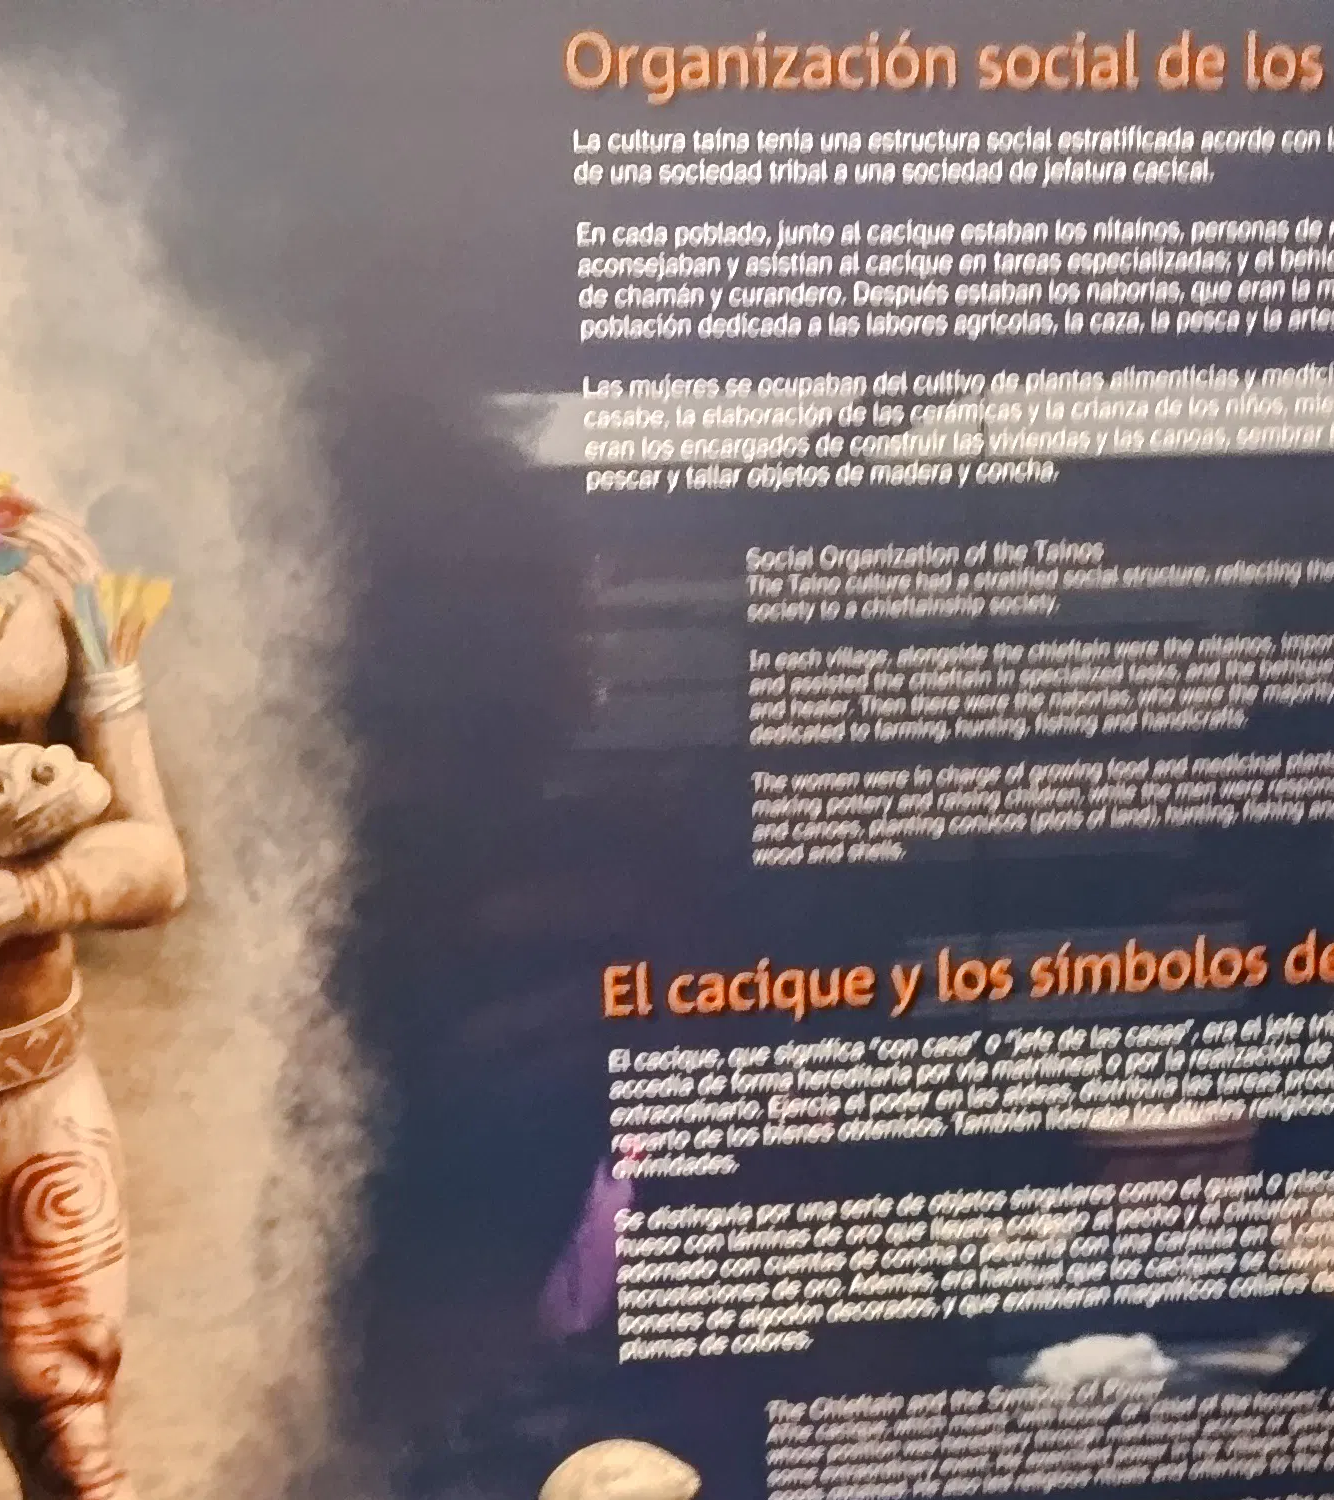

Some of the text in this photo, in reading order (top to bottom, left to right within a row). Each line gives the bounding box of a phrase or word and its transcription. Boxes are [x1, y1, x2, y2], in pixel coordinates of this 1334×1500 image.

[565, 29, 957, 104] Organización
[978, 29, 1140, 90] social
[1159, 29, 1226, 90] de
[1247, 29, 1324, 91] los
[572, 129, 602, 153] La
[607, 128, 686, 153] cultura
[820, 132, 862, 152] una
[868, 127, 981, 152] estructura
[986, 127, 1053, 152] social
[1057, 126, 1195, 151] estratificada
[1201, 126, 1275, 151] acorde
[1281, 131, 1321, 151] con
[573, 159, 604, 185] de
[609, 164, 653, 185] una
[658, 158, 763, 185] sociedad
[769, 158, 828, 184] tribal
[832, 163, 848, 184] a
[854, 163, 896, 184] una
[901, 158, 1004, 184] sociedad
[1008, 158, 1039, 184] de
[1042, 157, 1127, 187] jefatura
[576, 221, 607, 247] En
[611, 221, 668, 247] cada
[776, 220, 835, 249] junto
[839, 219, 861, 245] al
[866, 219, 956, 248] cacique
[960, 218, 1049, 243] estaban
[1054, 217, 1088, 243] los
[1189, 221, 1290, 245] personas
[1294, 216, 1324, 241] de
[577, 253, 722, 282] aconsejaban
[725, 257, 739, 280] y
[839, 251, 861, 275] al
[865, 250, 953, 279] cacique
[959, 254, 987, 274] en
[992, 248, 1063, 274] tareas
[1236, 251, 1248, 275] y
[1254, 246, 1275, 271] el
[578, 285, 609, 308] de
[710, 288, 724, 311] y
[954, 279, 1043, 303] estaban
[1048, 278, 1081, 302] los
[1190, 281, 1233, 305] que
[1237, 281, 1286, 301] eran
[1291, 276, 1311, 300] la
[697, 312, 802, 338] dedicada
[808, 317, 823, 337] a
[827, 311, 861, 337] las
[865, 310, 949, 336] labores
[1063, 308, 1084, 334] la
[1150, 307, 1171, 332] la
[1176, 311, 1241, 336] pesca
[1245, 310, 1258, 335] y
[1262, 305, 1283, 331] la
[582, 376, 624, 399] Las
[628, 374, 720, 402] mujeres
[724, 378, 753, 397] se
[757, 371, 868, 399] ocupaban
[871, 370, 908, 394] del
[912, 368, 986, 393] cultivo
[990, 367, 1020, 391] de
[1024, 366, 1105, 394] plantas
[1109, 364, 1240, 388] alimenticias
[1244, 368, 1258, 390] y
[585, 468, 661, 492] pescar
[666, 468, 680, 492] y
[685, 462, 741, 488] tallar
[747, 462, 831, 491] objetos
[835, 461, 864, 486] de
[869, 461, 953, 486] madera
[957, 465, 970, 489] y
[603, 962, 653, 1018] El
[667, 957, 875, 1022] cacique
[889, 962, 921, 1017] y
[936, 946, 1014, 1003] los
[1029, 934, 1269, 998] símbolos
